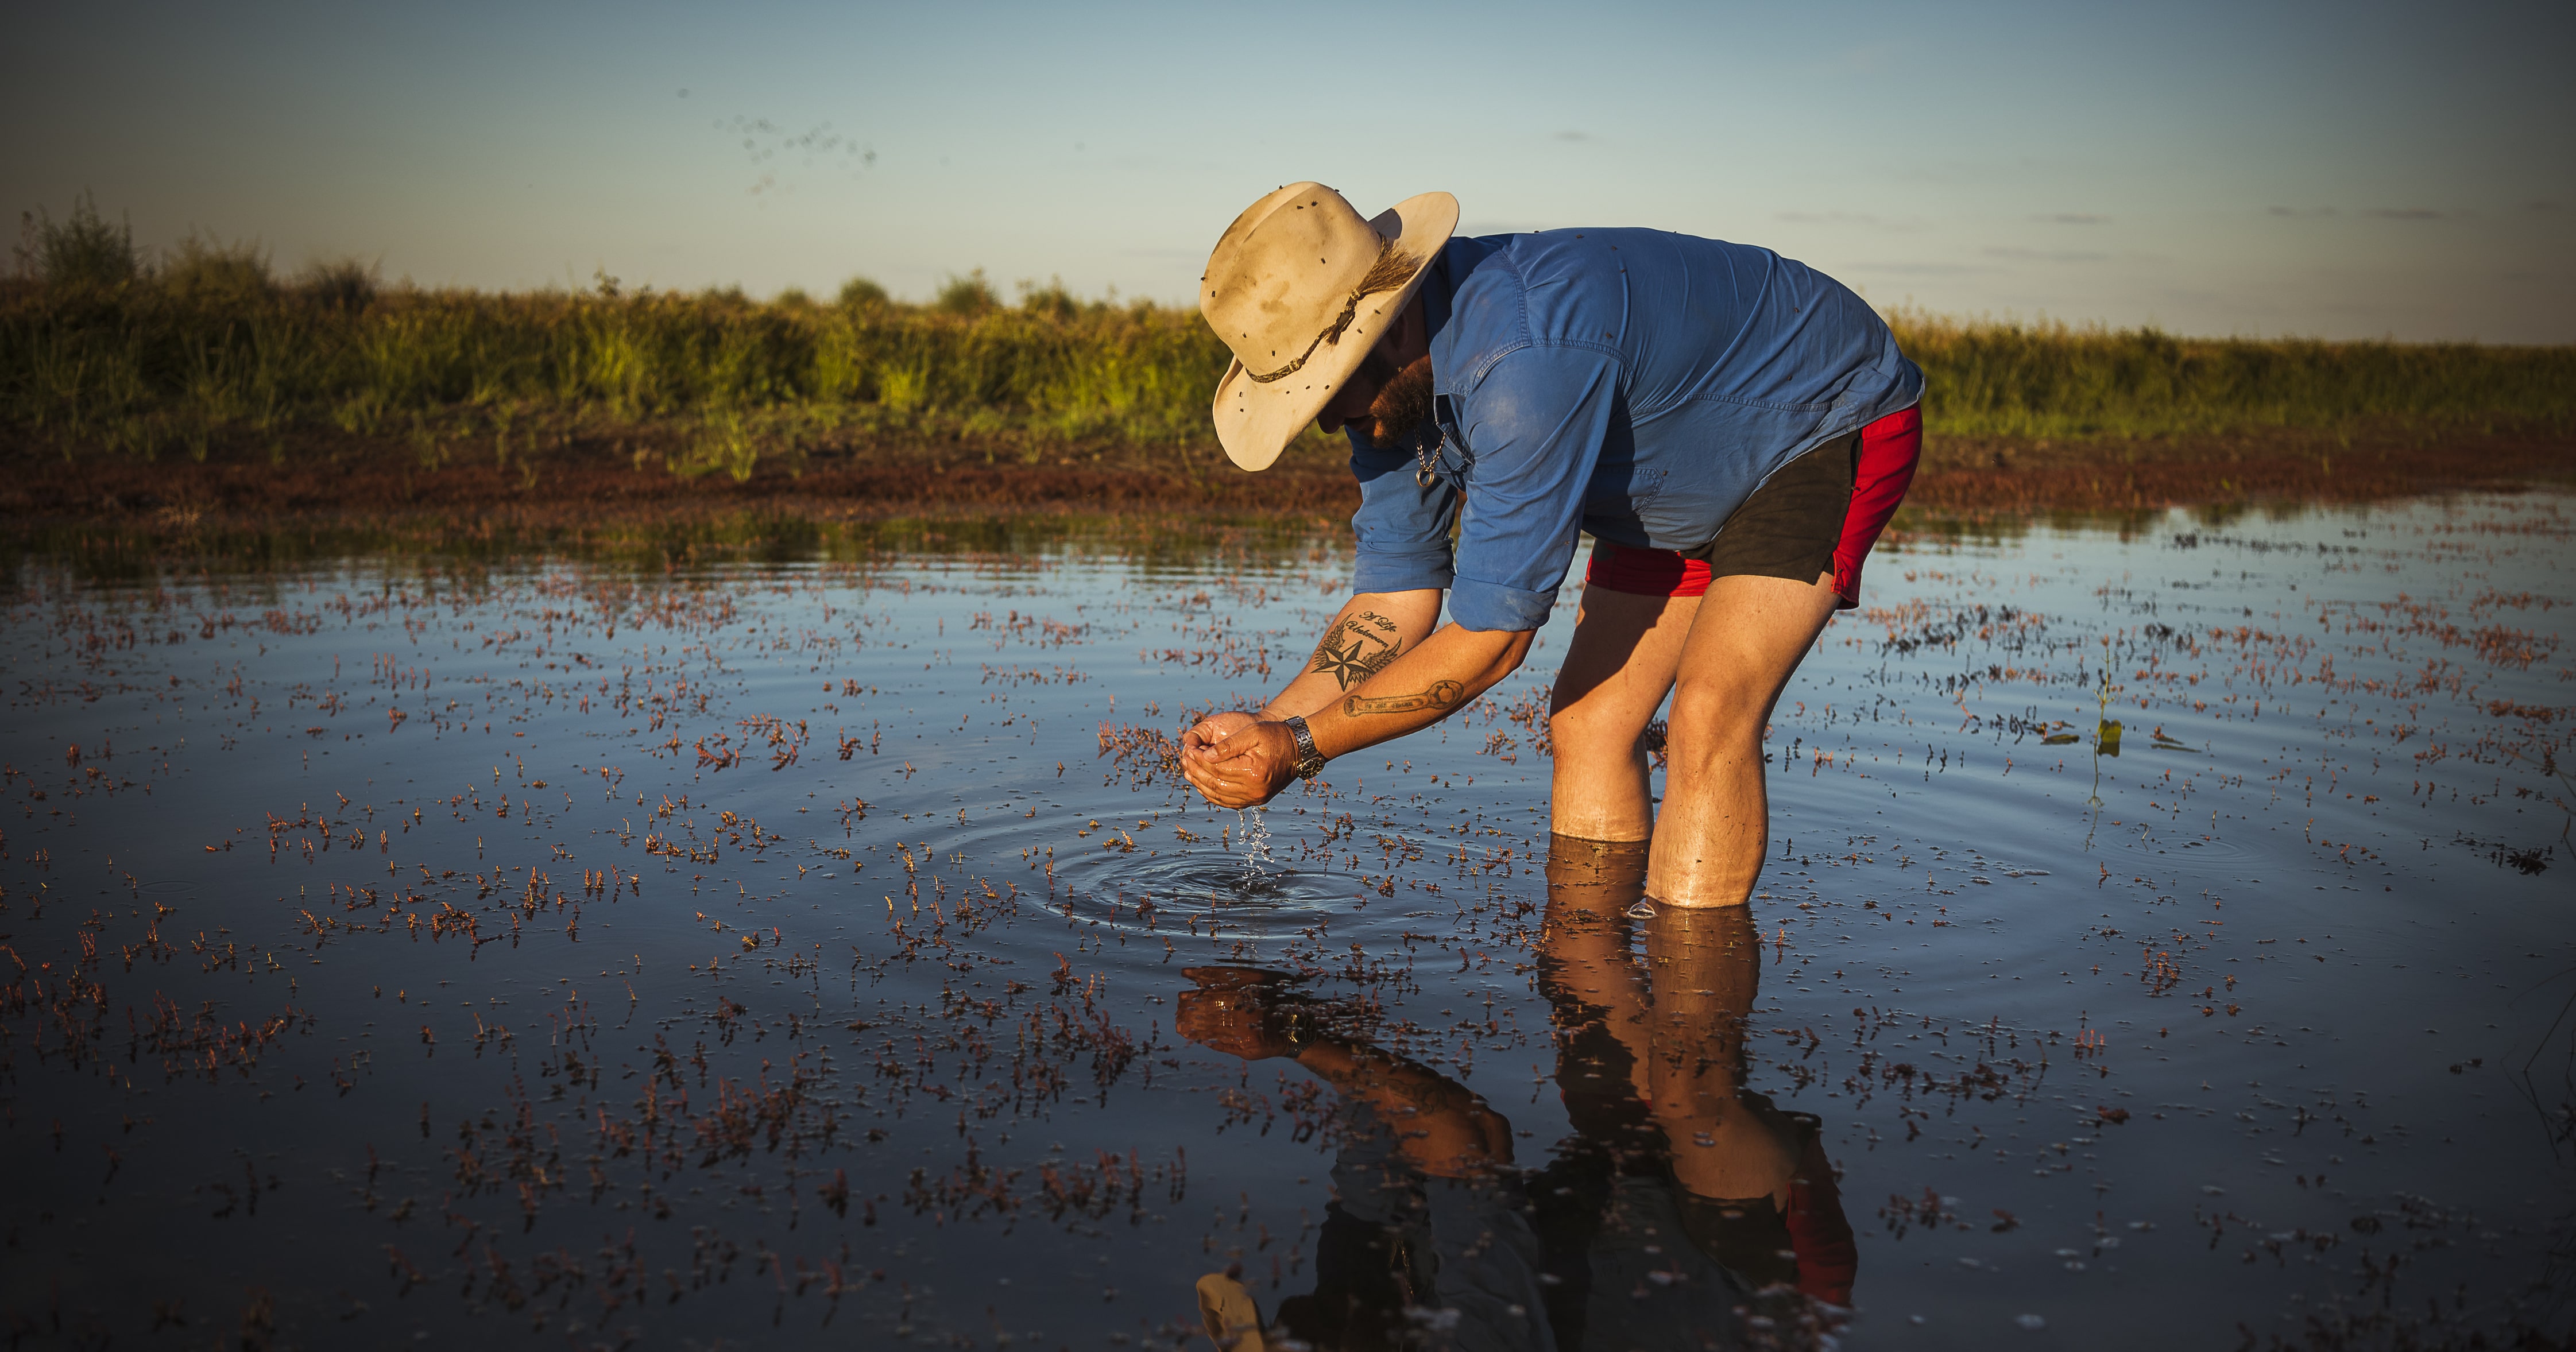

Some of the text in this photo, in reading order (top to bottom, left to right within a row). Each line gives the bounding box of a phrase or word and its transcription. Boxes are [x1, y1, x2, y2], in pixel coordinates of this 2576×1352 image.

[1359, 611, 1397, 633] A Life
[1345, 621, 1389, 648] Unknown
